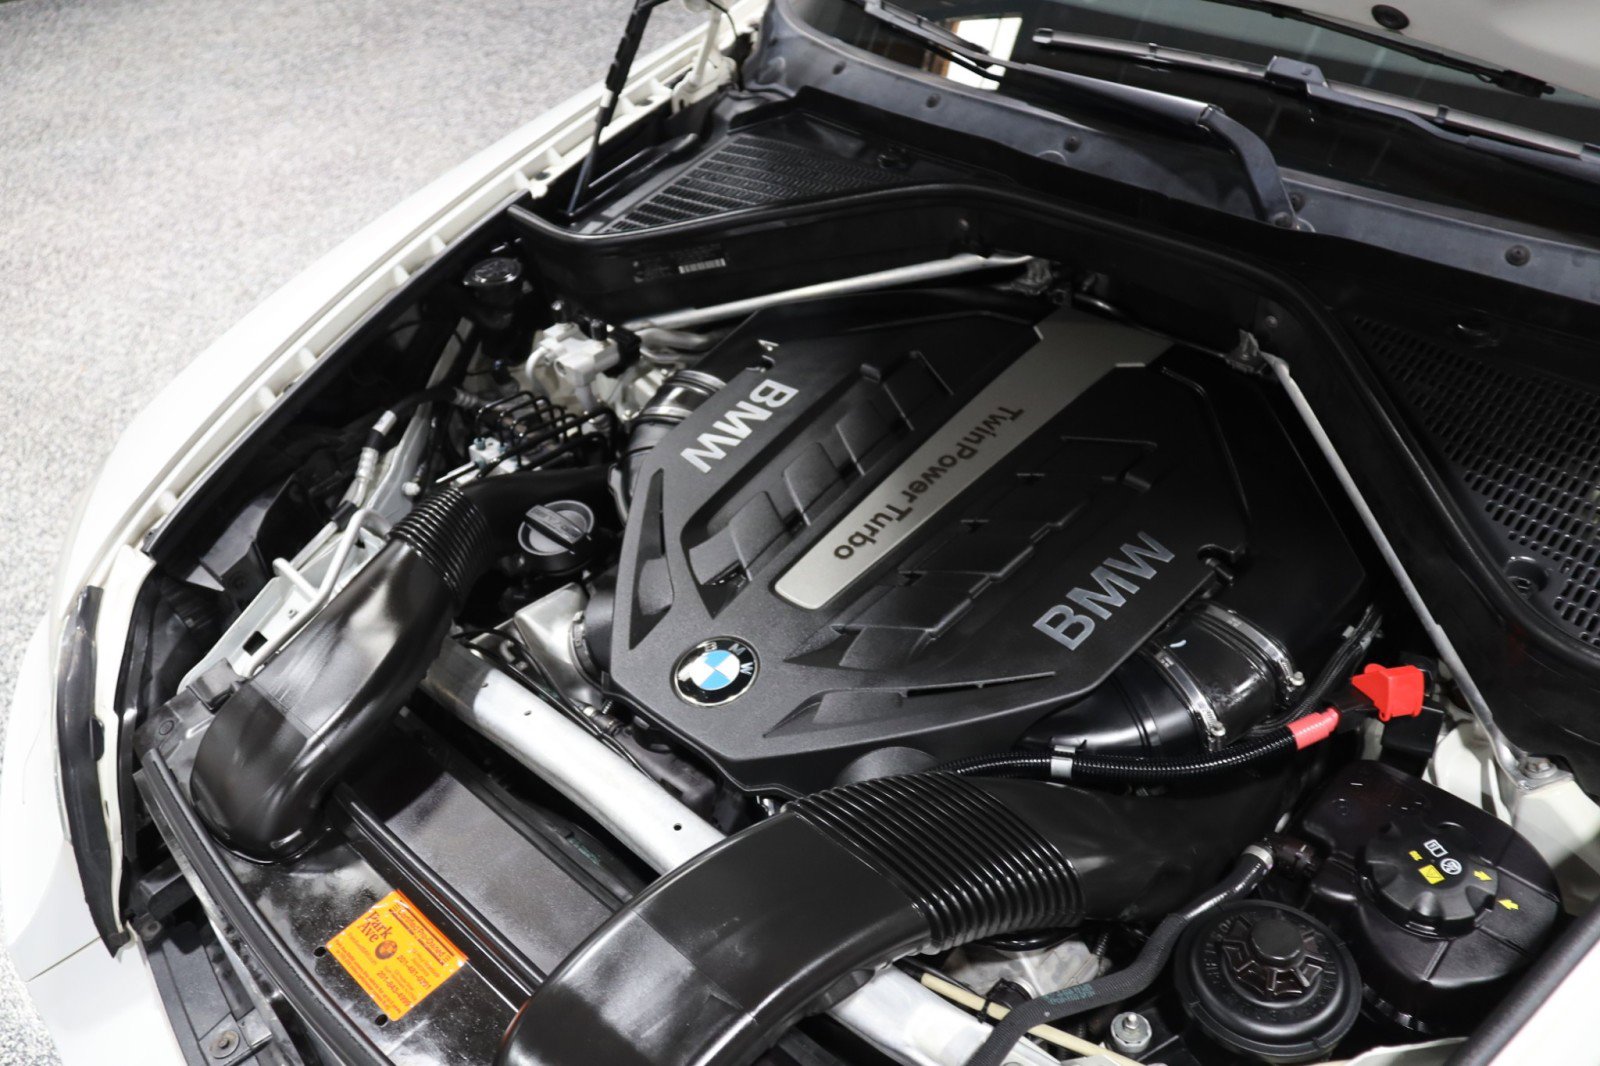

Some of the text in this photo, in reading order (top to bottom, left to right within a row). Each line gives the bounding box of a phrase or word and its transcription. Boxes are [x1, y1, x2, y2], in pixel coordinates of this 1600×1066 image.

[680, 379, 799, 474] BMW
[1032, 531, 1175, 651] BMW
[704, 641, 755, 676] BMW
[356, 920, 380, 943] Ave
[364, 910, 394, 940] Park
